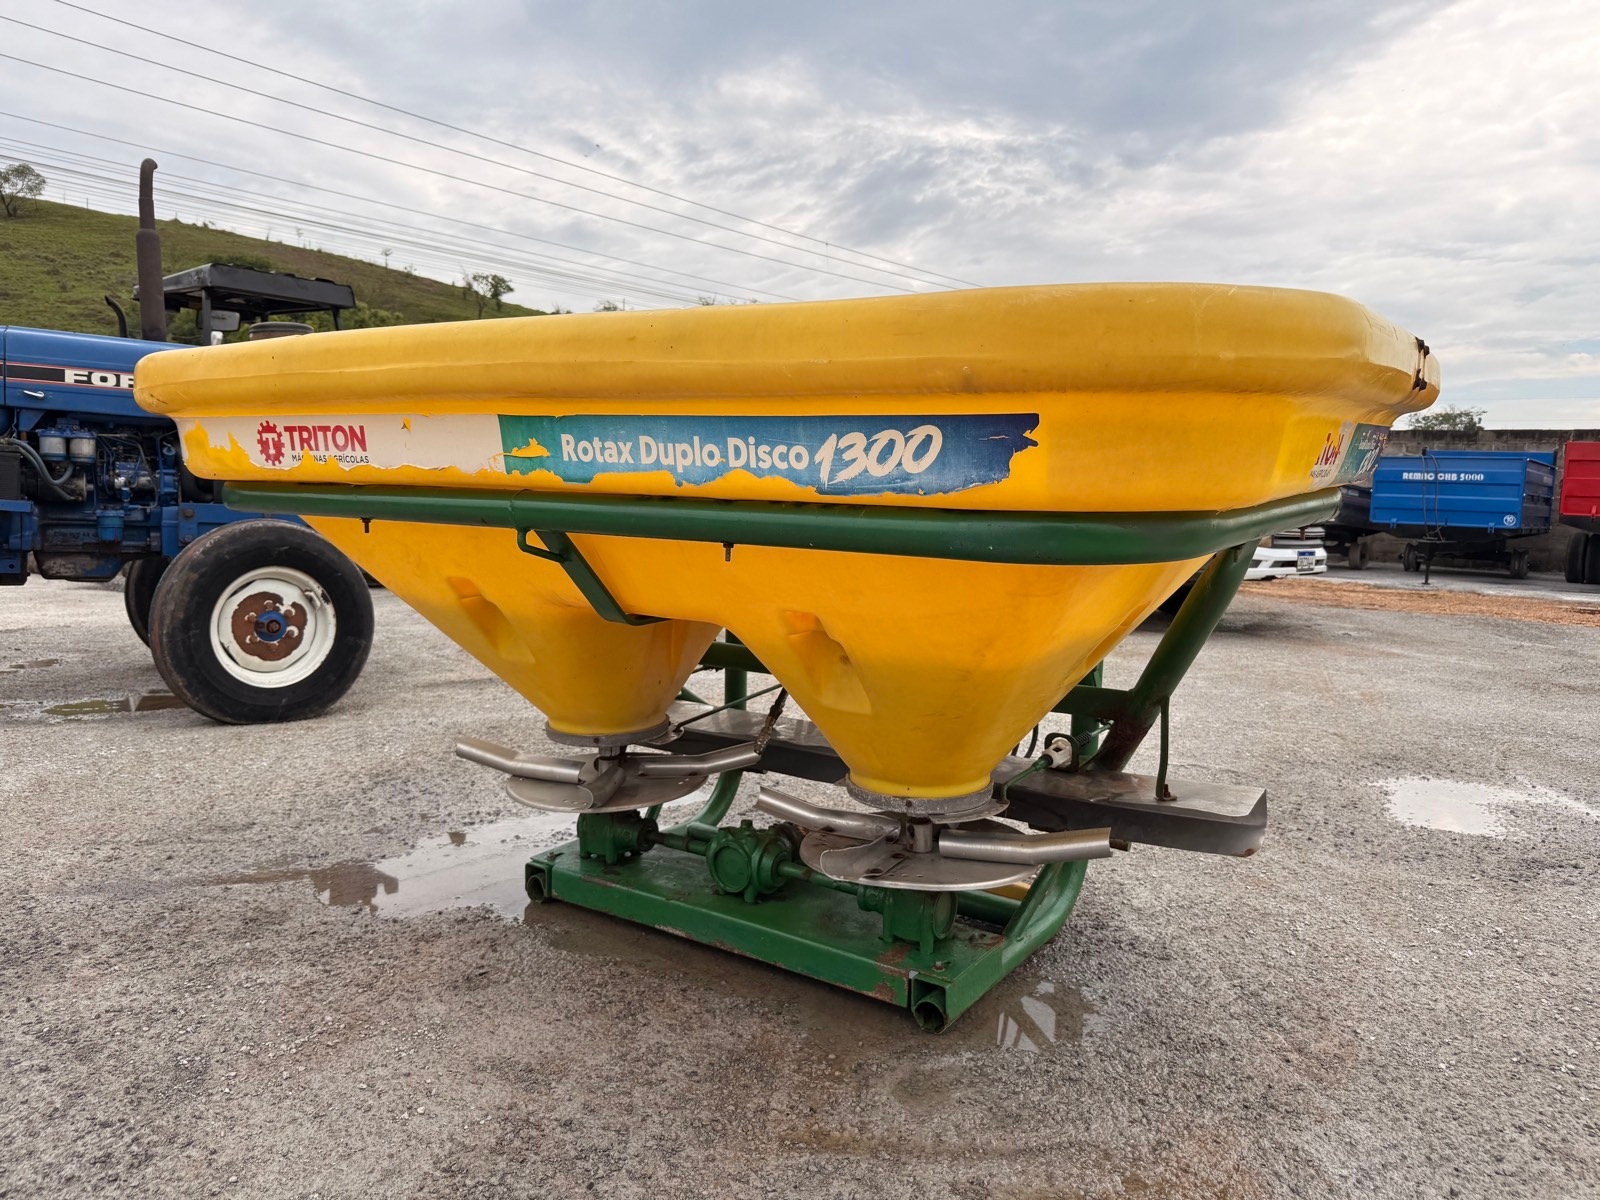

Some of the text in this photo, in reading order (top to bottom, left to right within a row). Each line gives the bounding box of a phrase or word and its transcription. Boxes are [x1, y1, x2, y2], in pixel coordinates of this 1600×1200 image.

[64, 369, 134, 389] FOR
[283, 425, 368, 452] TRITON
[328, 454, 370, 464] GRÍCOLAS
[560, 424, 943, 490] Rotax Duplo Disco 1300
[1459, 472, 1485, 481] 5000
